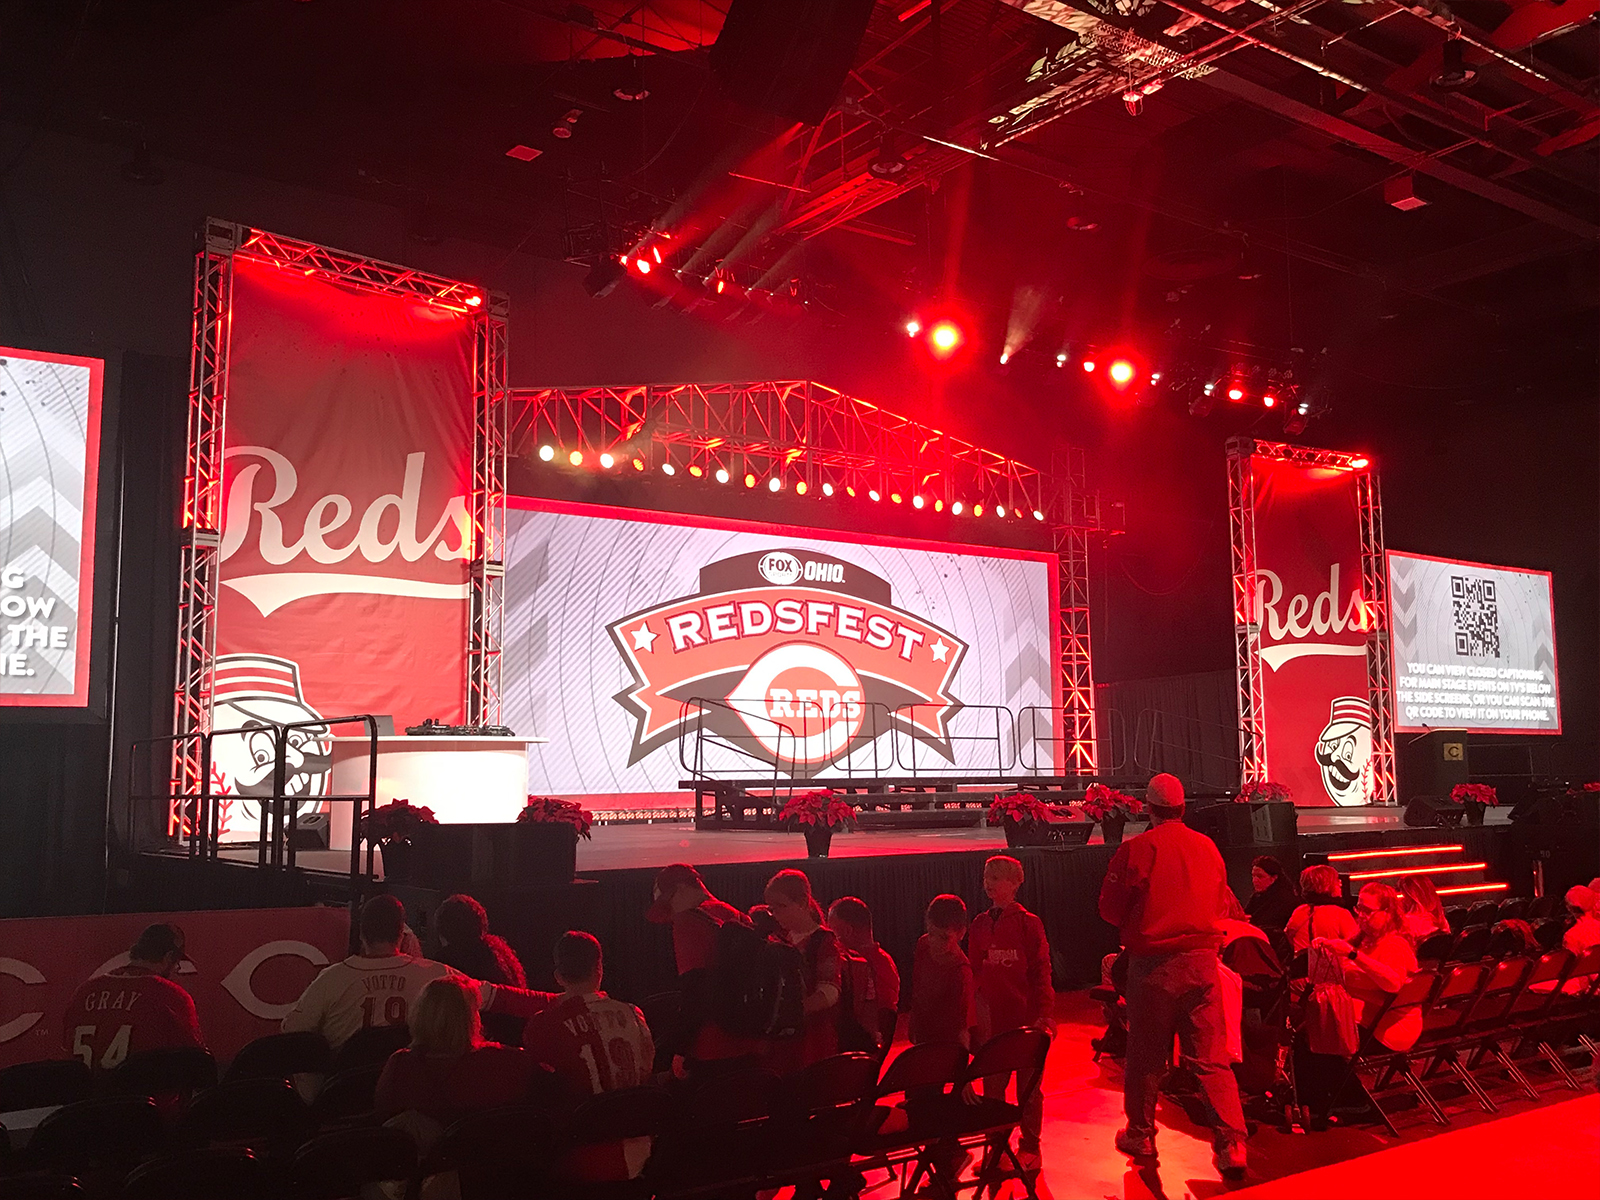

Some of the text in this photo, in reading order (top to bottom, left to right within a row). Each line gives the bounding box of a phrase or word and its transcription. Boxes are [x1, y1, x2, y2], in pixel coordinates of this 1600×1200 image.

[216, 446, 472, 565] Reds
[768, 557, 793, 572] FOX
[1250, 563, 1367, 641] Reds
[6, 623, 69, 648] THE
[664, 598, 925, 662] REDSFEST
[1406, 662, 1425, 675] YOU
[1426, 663, 1445, 676] CAN
[1445, 664, 1466, 677] VIEW
[1466, 666, 1497, 679] CLOSED
[1400, 676, 1418, 689] FOR
[1419, 677, 1441, 689] MAIN
[1441, 678, 1467, 691] STAGE
[1496, 681, 1509, 693] ON
[1526, 683, 1551, 695] BELOW
[770, 688, 861, 718] REDS
[1396, 691, 1413, 703] THE
[1413, 692, 1434, 704] SIDE
[1473, 694, 1486, 706] OR
[1485, 694, 1503, 706] YOU
[1503, 695, 1520, 707] CAN
[1520, 696, 1541, 708] SCAN
[1405, 706, 1419, 720] QR
[1419, 706, 1444, 719] CODE
[1443, 707, 1456, 719] TO
[1456, 707, 1477, 720] VIEW
[1477, 708, 1486, 720] IT
[1485, 708, 1499, 720] ON
[1499, 708, 1521, 720] YOUR
[360, 974, 407, 991] VOTTO
[84, 990, 141, 1012] GRAY
[73, 1024, 133, 1070] 54
